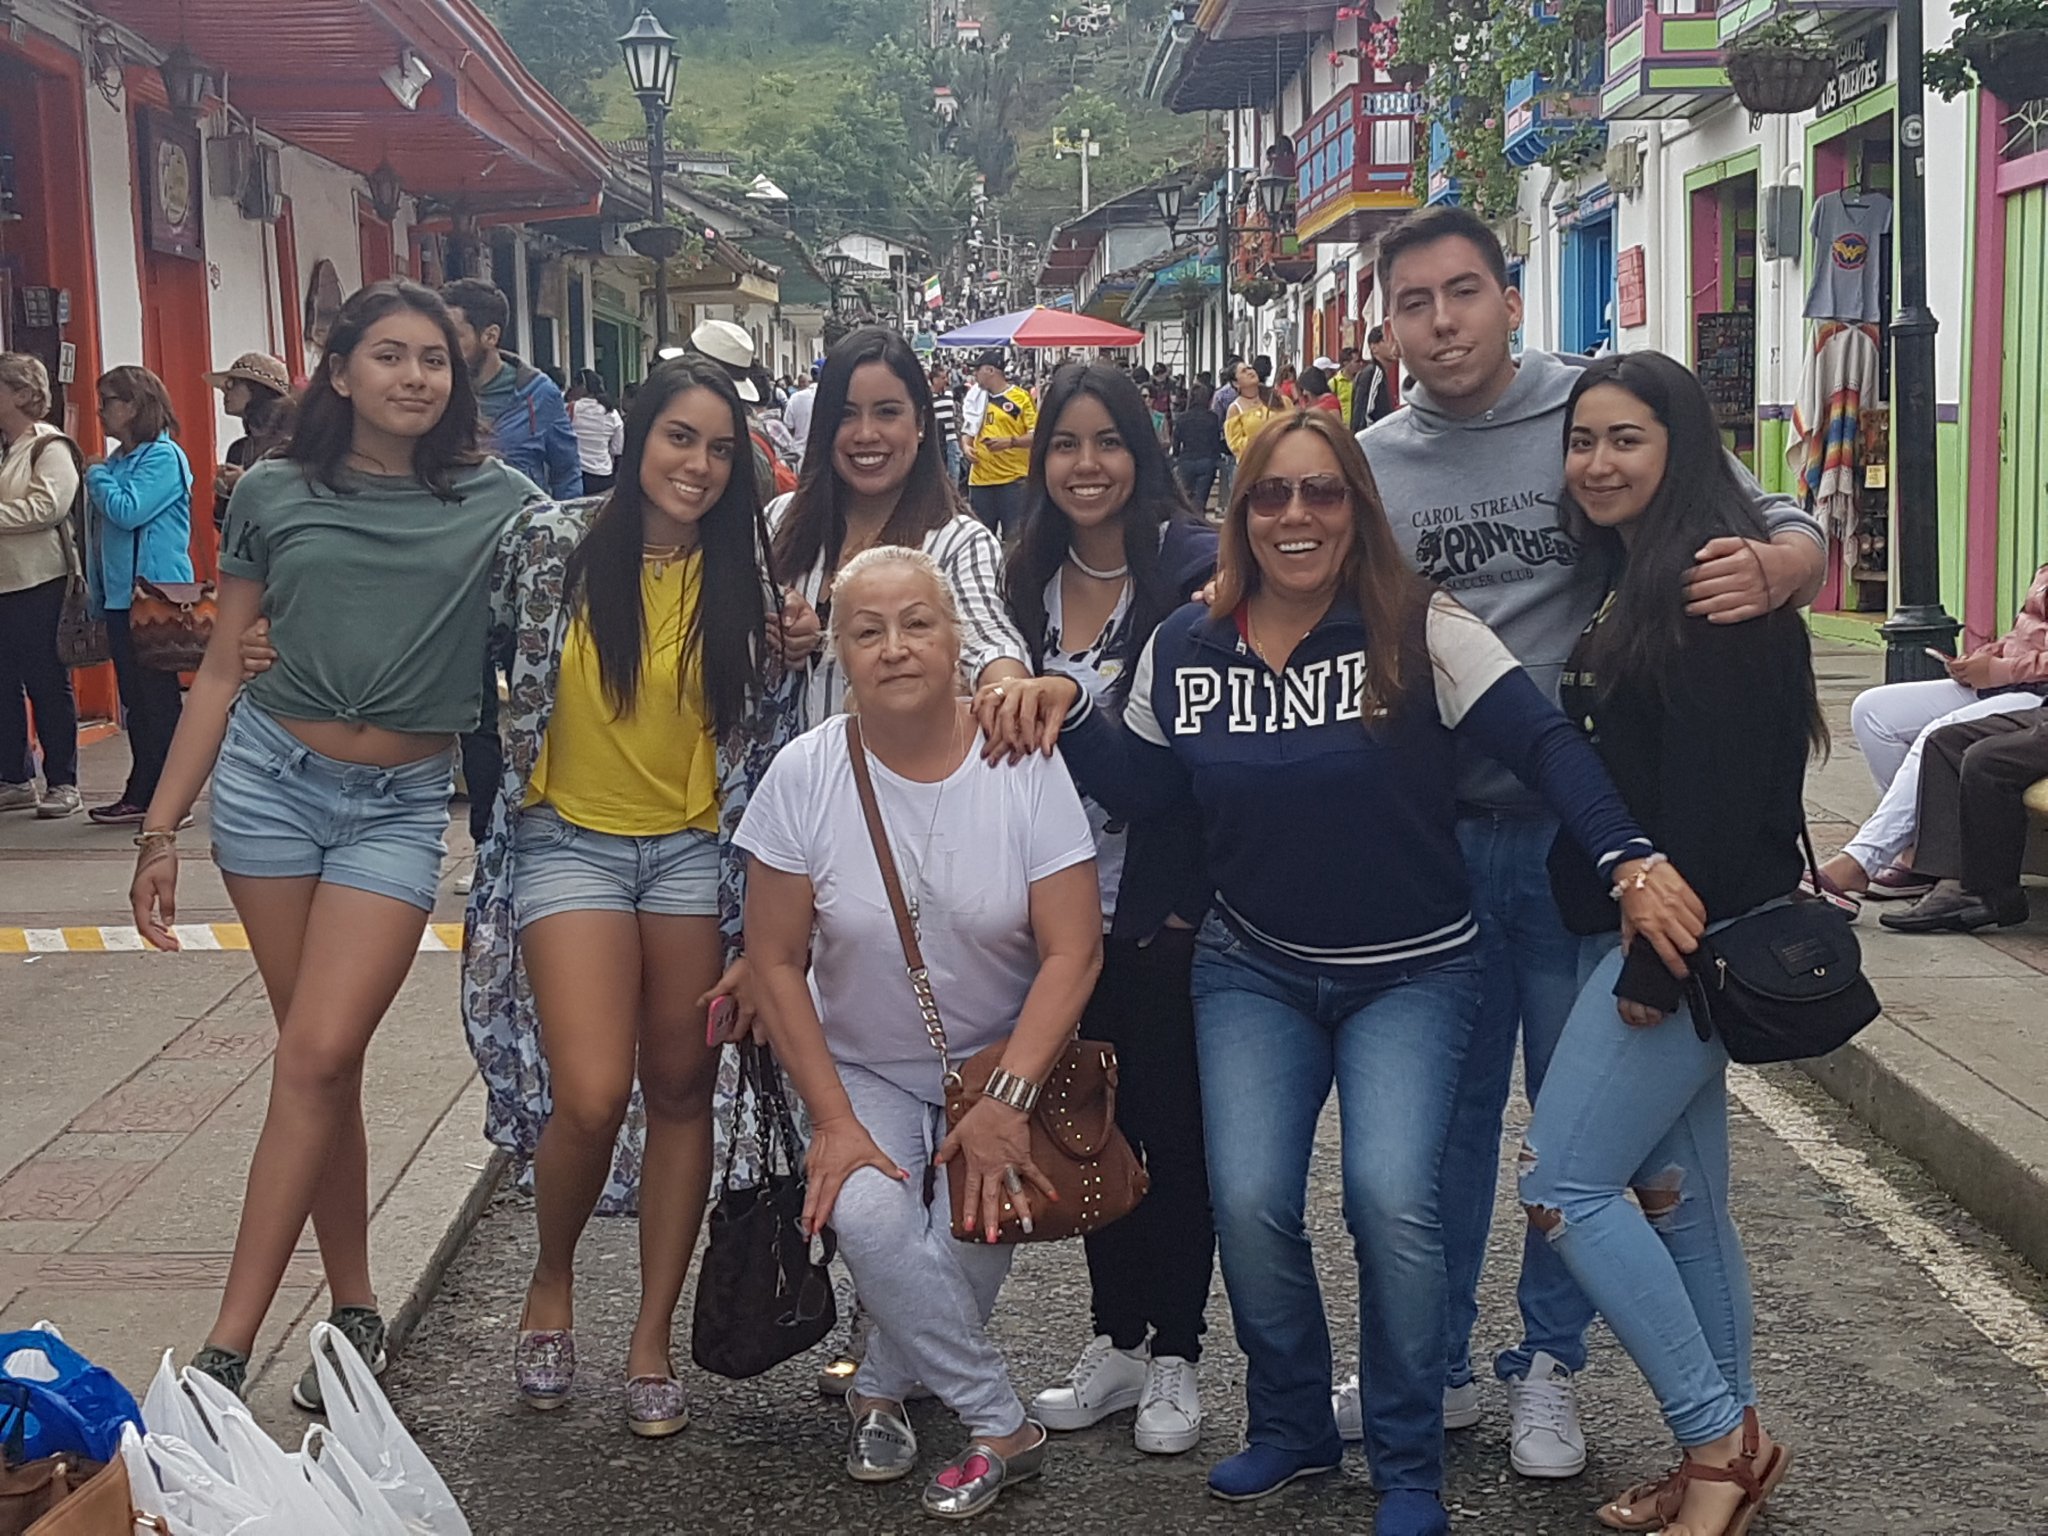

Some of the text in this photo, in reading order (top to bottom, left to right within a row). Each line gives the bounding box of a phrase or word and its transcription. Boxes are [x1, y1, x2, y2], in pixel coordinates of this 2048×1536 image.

[1412, 490, 1534, 528] CAROL STREAM
[1500, 567, 1534, 583] CLUB
